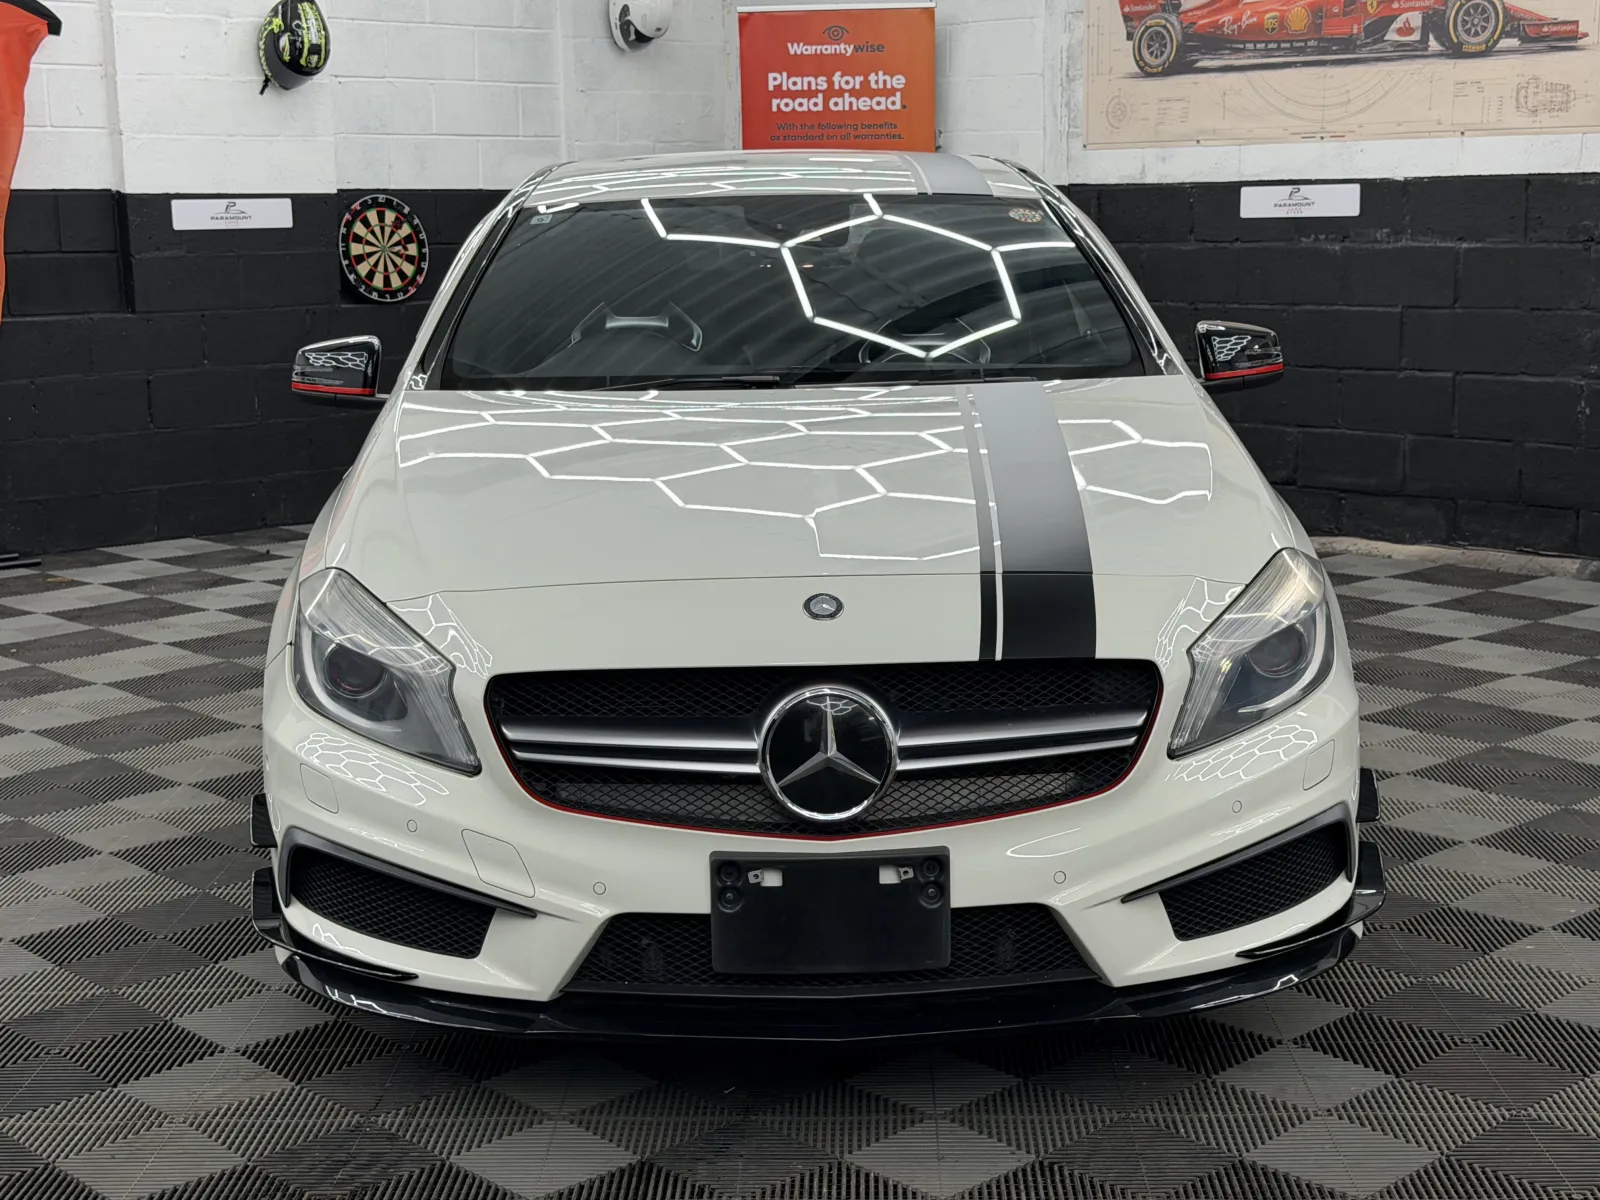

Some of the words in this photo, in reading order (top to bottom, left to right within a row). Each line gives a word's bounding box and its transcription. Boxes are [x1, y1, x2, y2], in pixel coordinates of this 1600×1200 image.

[787, 41, 885, 56] Warrantywise
[768, 71, 828, 91] Plans
[832, 71, 864, 90] for
[868, 70, 906, 89] the
[772, 93, 823, 112] road
[829, 91, 907, 111] ahead.
[776, 122, 798, 131] With
[800, 122, 815, 131] the
[817, 122, 858, 131] following
[861, 121, 898, 130] benefits
[783, 133, 824, 141] standard
[840, 132, 851, 140] all
[853, 132, 905, 140] warranties.
